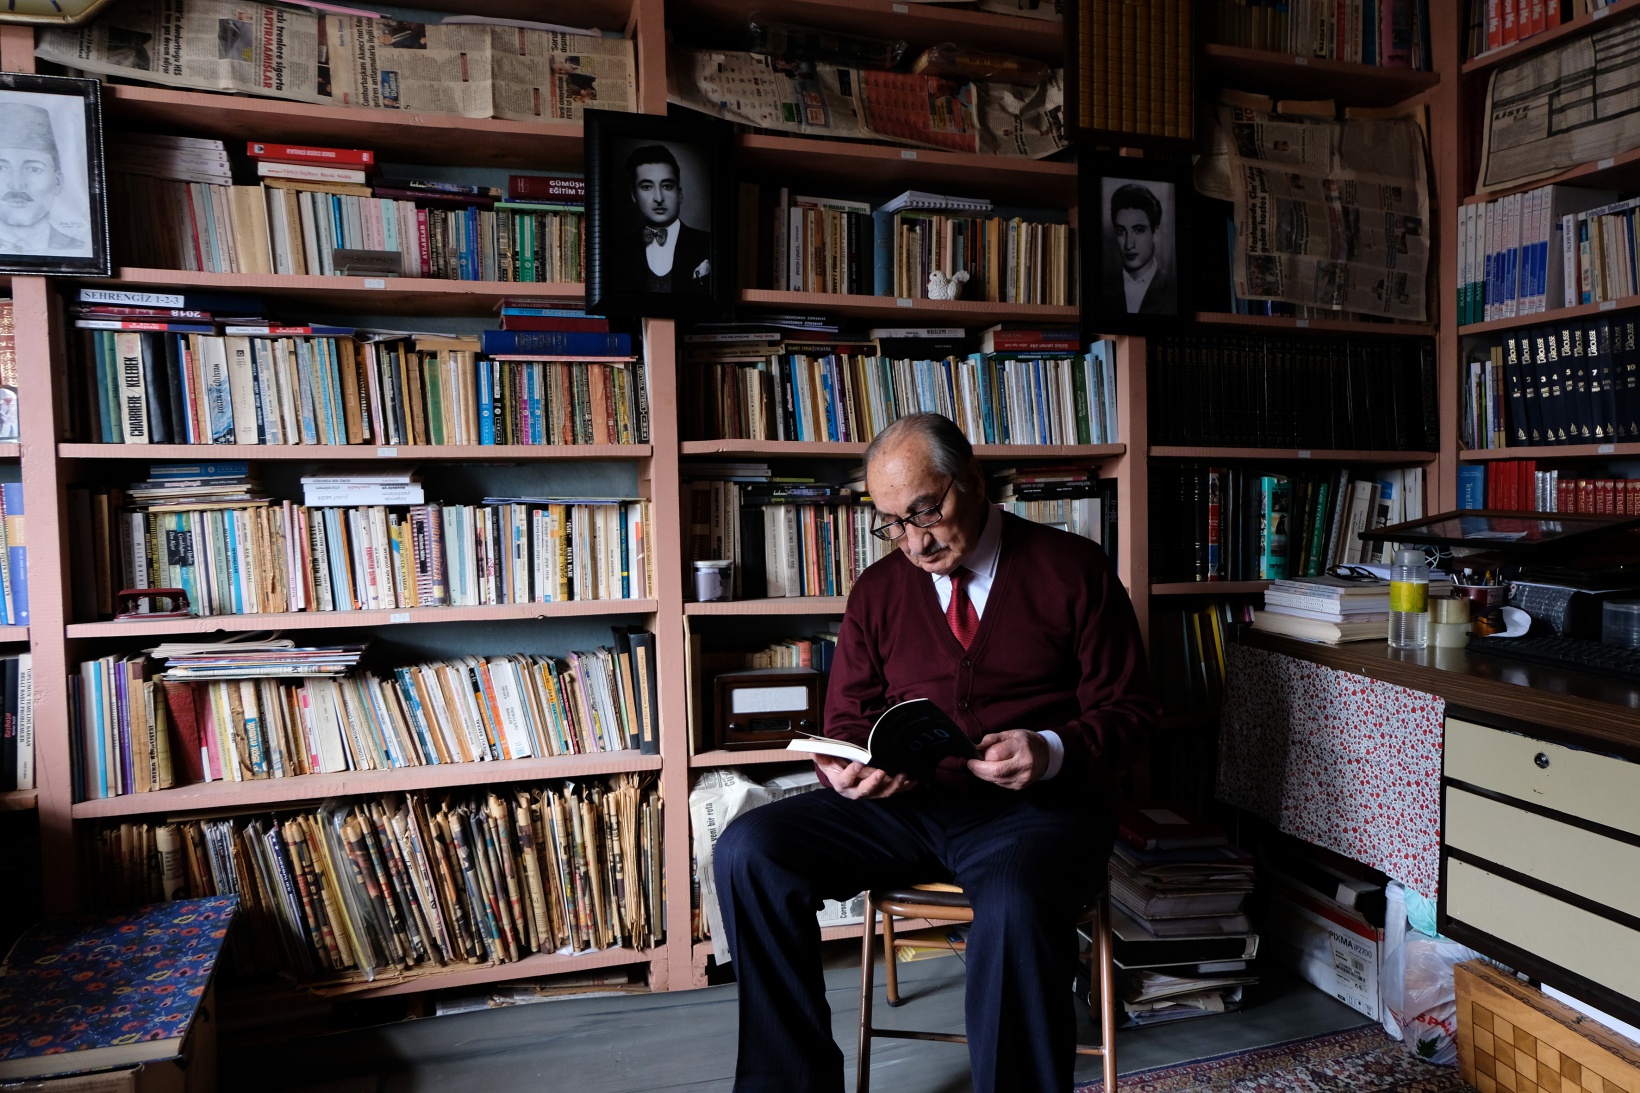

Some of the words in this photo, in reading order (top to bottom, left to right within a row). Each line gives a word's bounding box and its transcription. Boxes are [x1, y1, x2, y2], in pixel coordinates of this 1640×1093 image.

[275, 26, 285, 60] trenlere
[173, 64, 182, 76] HES
[274, 61, 285, 91] sigorta
[369, 45, 380, 87] antlaşmalarla
[360, 62, 371, 107] Cumhurbaşkanı
[372, 88, 382, 108] getiren
[549, 180, 585, 189] GÜMÜŞH
[549, 186, 576, 195] EĞİTİM
[1258, 196, 1267, 225] hostes
[1249, 202, 1258, 252] Hastanede
[420, 224, 428, 260] AYLAKLAR
[1259, 228, 1269, 253] gelen
[84, 291, 153, 304] ŞEHRENGİZ
[156, 295, 180, 304] 1-2-3
[171, 310, 201, 318] 2018
[123, 356, 140, 387] KELEBEK
[1551, 373, 1558, 381] 4
[1565, 368, 1572, 376] 5
[18, 689, 26, 704] BAŞLI
[150, 762, 158, 784] ARENA
[707, 816, 716, 827] bir
[1329, 931, 1354, 950] PIXMA
